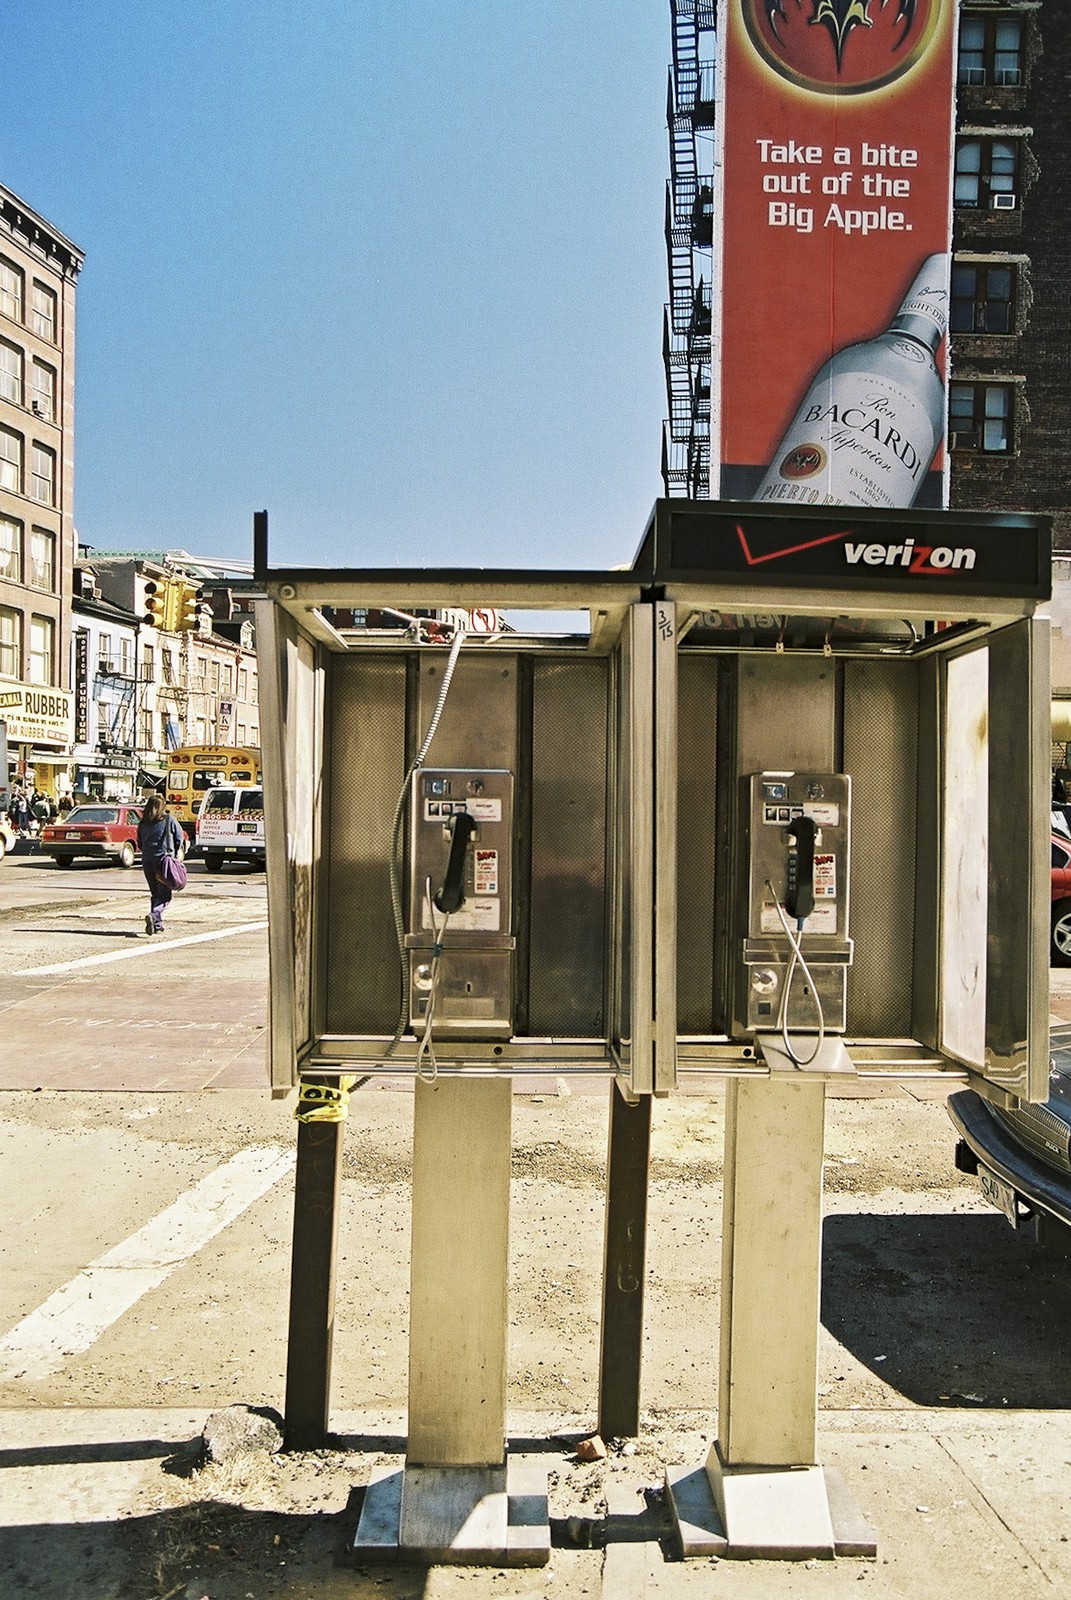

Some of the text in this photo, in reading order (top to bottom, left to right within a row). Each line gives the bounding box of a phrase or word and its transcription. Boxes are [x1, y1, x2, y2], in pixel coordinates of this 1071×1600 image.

[755, 139, 918, 167] Take a bite
[762, 171, 910, 198] out of the
[768, 201, 913, 236] Big Apple.
[860, 392, 896, 420] Ron
[803, 404, 922, 481] BACARDI
[761, 483, 820, 505] PUERTO
[844, 538, 976, 574] verizon
[25, 692, 69, 719] RUBBER
[79, 683, 87, 741] FURNITURE
